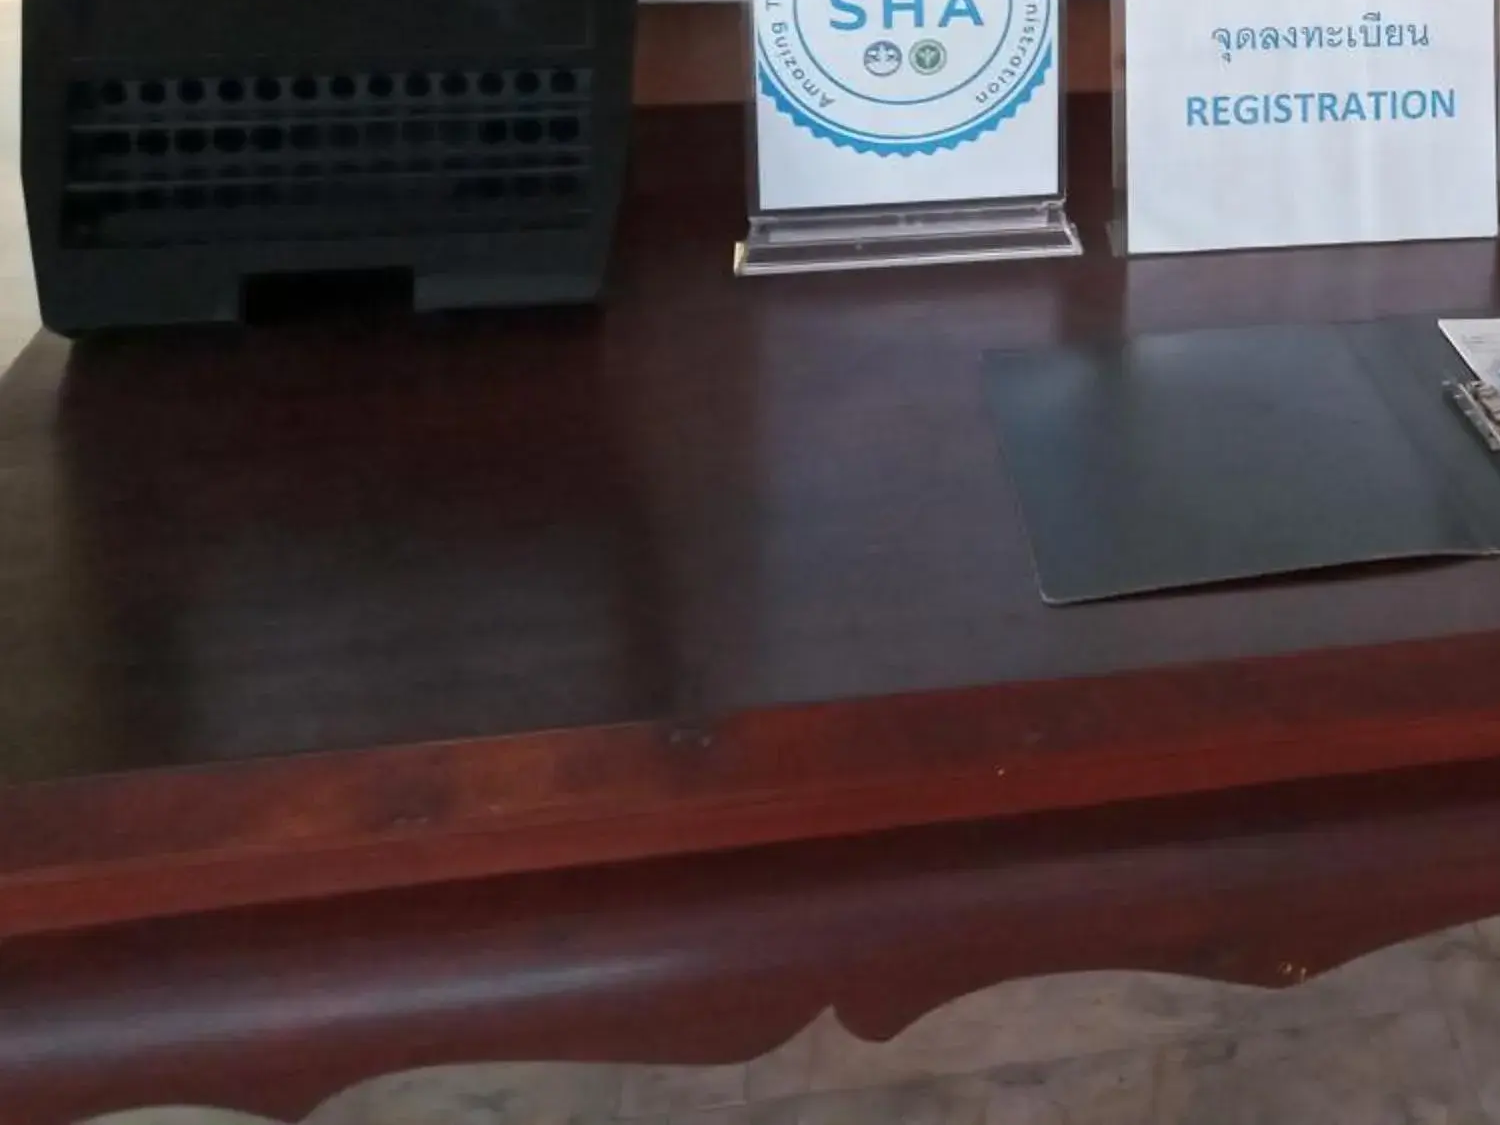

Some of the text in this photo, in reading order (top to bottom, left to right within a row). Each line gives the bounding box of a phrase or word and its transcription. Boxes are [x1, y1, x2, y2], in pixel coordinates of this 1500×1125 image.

[1211, 11, 1430, 63] จุดลงทะเบียน
[771, 21, 837, 109] Amazing
[1186, 89, 1456, 127] REGISTRATION
